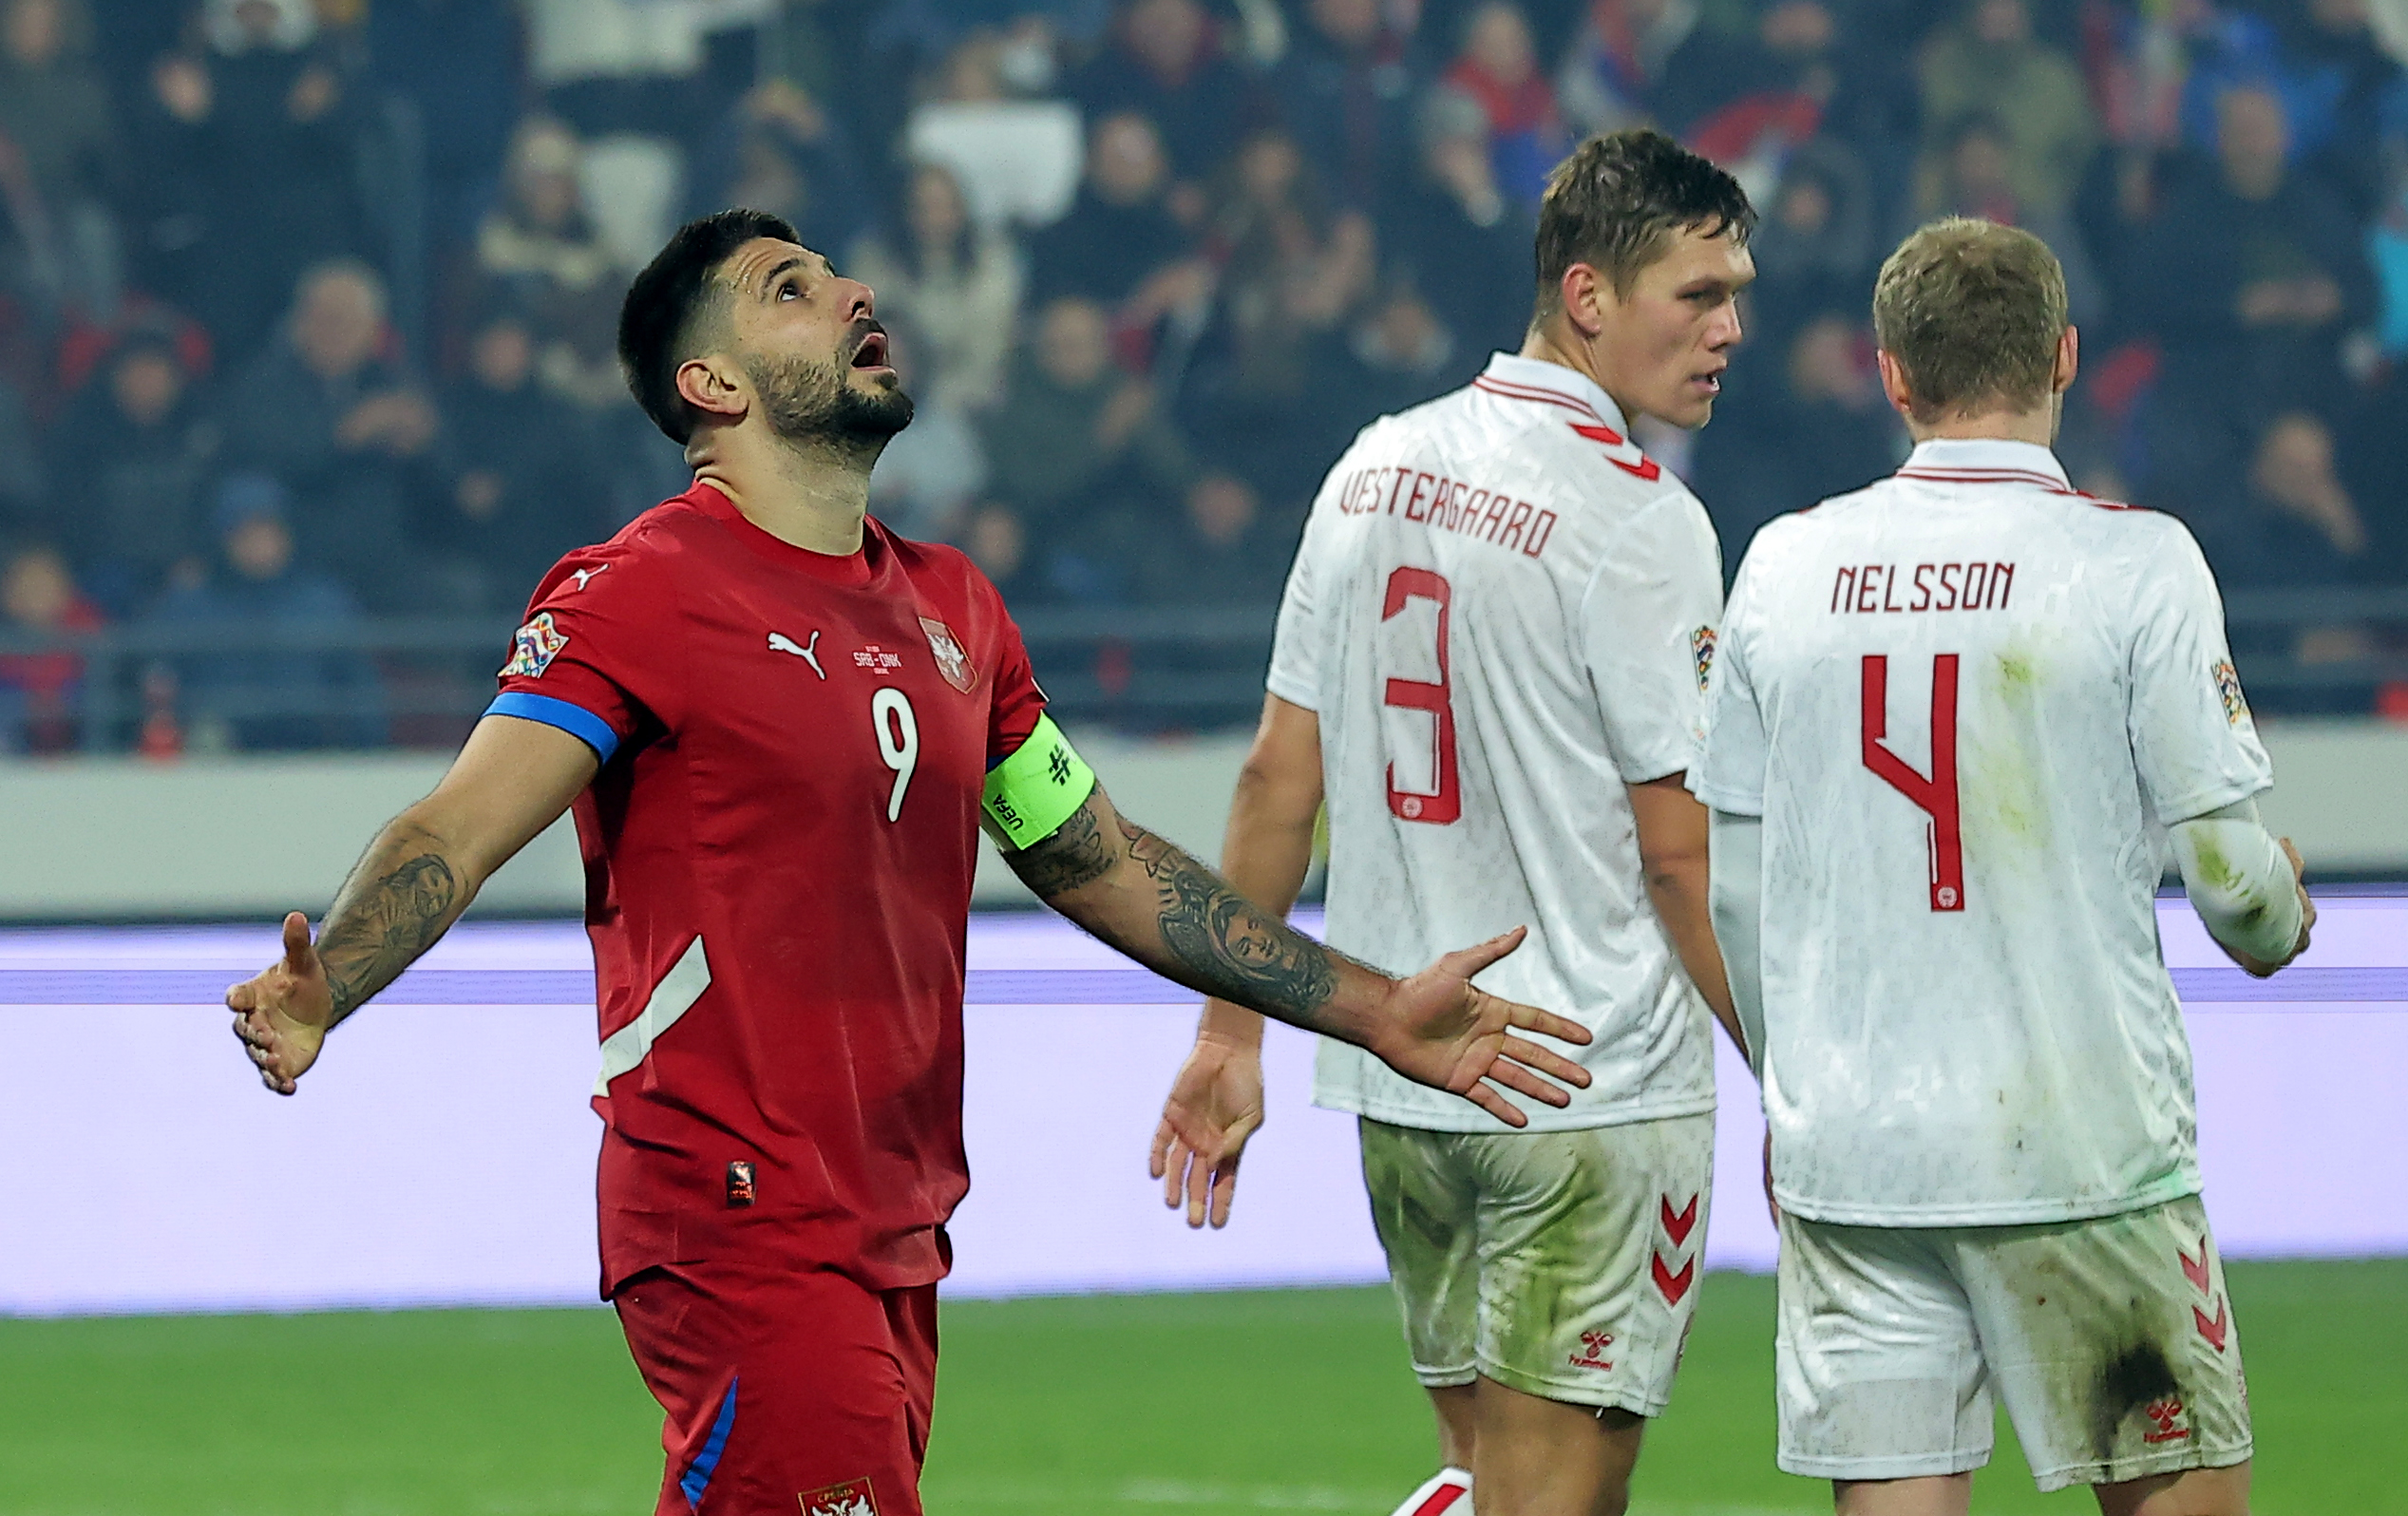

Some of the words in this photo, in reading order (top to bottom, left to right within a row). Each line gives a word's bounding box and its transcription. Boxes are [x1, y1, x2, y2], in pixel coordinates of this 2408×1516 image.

[1339, 466, 1558, 559] VESTERGAARD
[1830, 562, 2016, 614] NELSSON
[1381, 566, 1462, 825] 3
[872, 688, 919, 823] 9
[993, 793, 1024, 831] UEFA
[1862, 654, 1964, 912] 4
